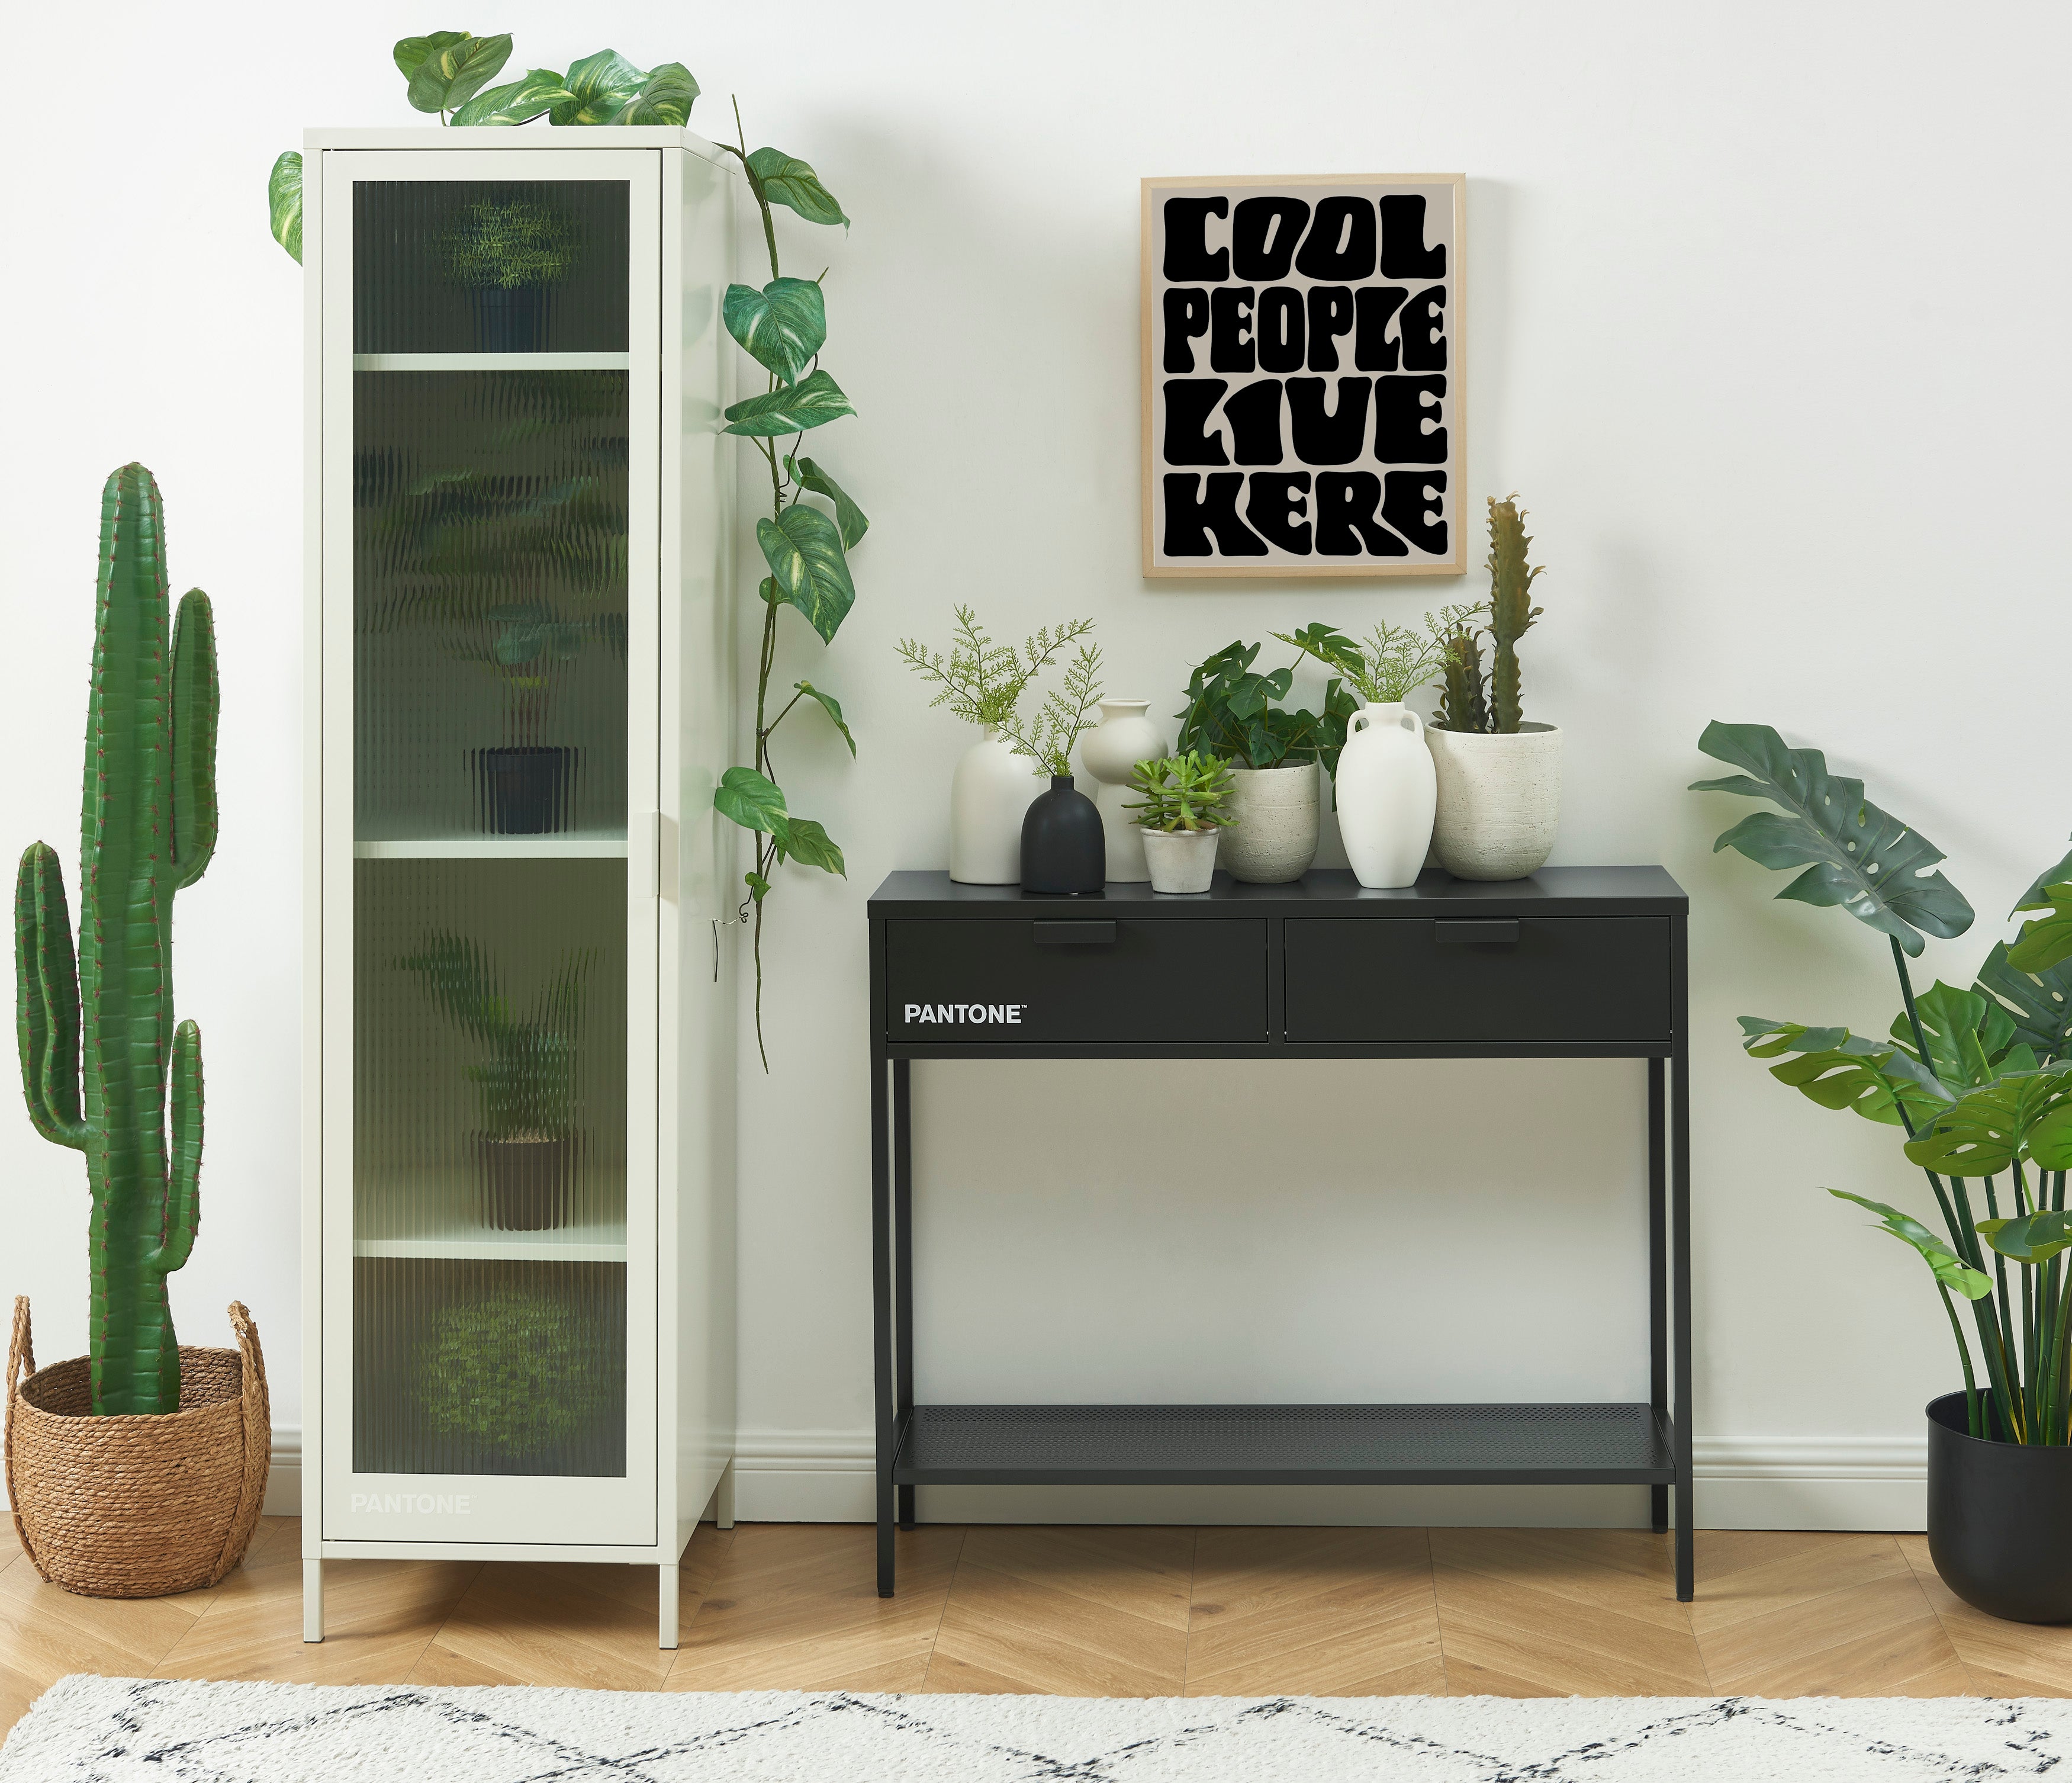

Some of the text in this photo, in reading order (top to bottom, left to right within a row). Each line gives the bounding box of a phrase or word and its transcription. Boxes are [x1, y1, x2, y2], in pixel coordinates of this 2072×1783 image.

[1163, 194, 1446, 282] COOL
[1163, 285, 1447, 374] PEOPLE
[1163, 374, 1448, 466] LIVE
[1163, 470, 1448, 557] HERE
